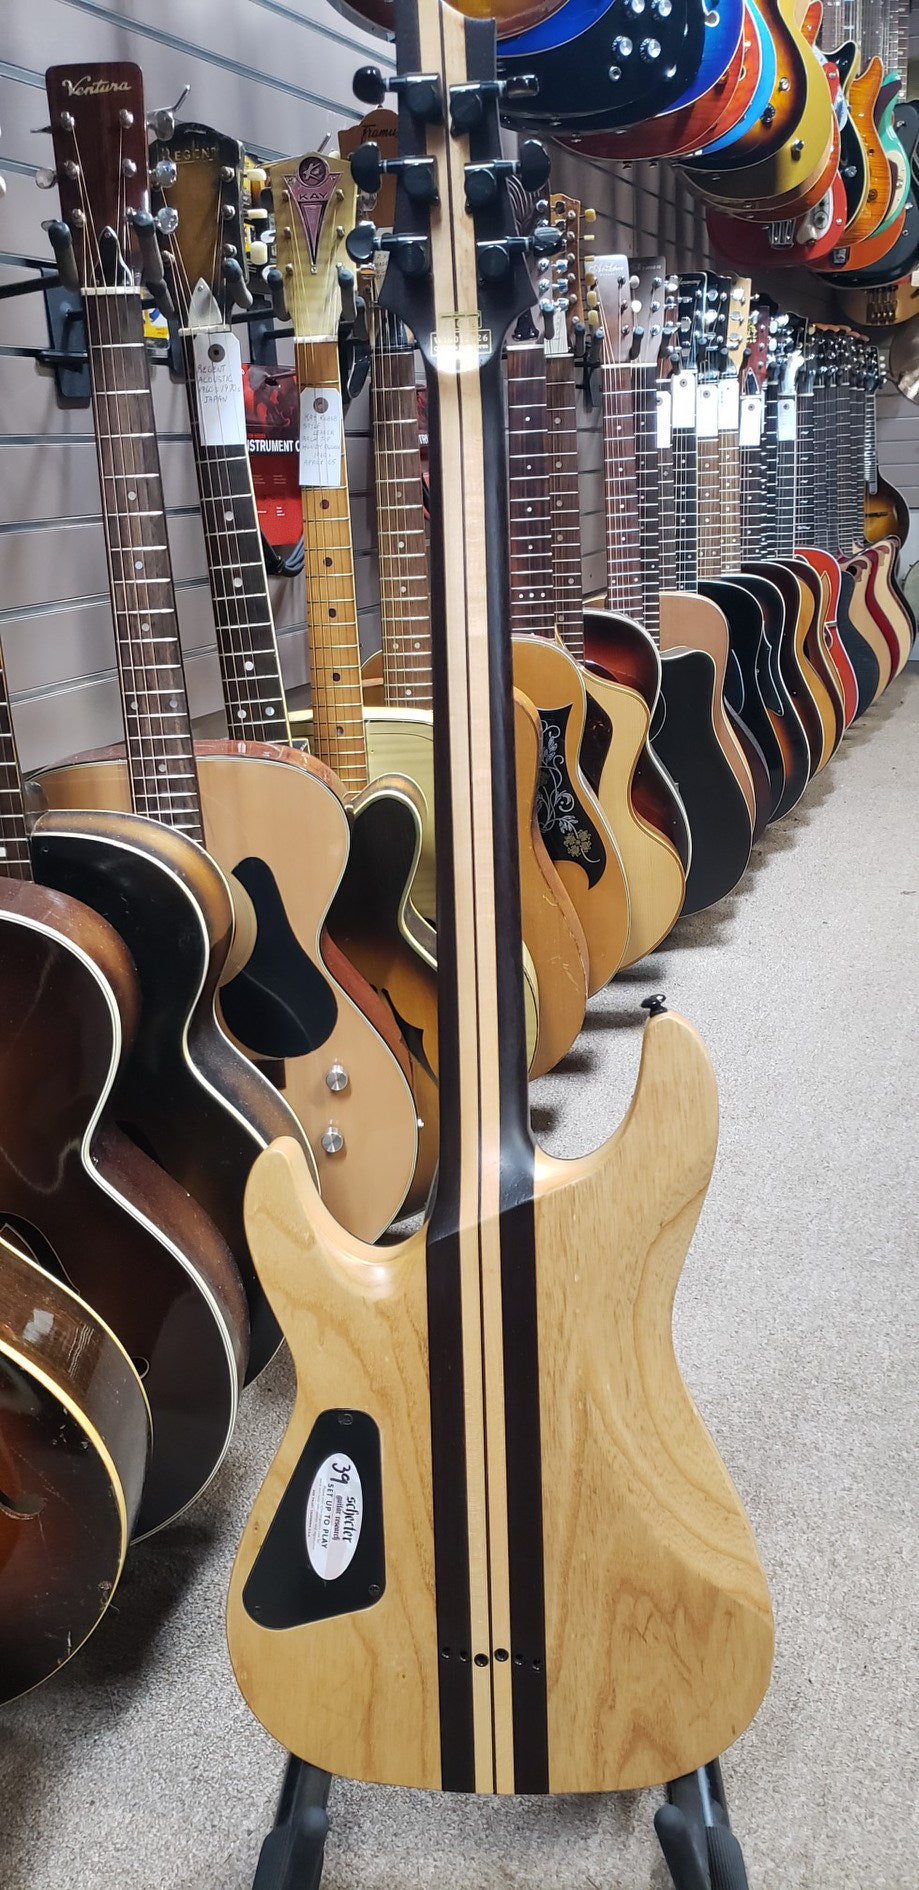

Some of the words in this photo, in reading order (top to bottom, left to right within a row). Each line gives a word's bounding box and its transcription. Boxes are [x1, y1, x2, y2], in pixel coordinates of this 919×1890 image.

[62, 75, 132, 97] Ventura
[361, 124, 398, 144] Framu
[299, 192, 328, 200] KAY
[330, 1463, 351, 1484] 39
[327, 1483, 335, 1497] SET
[325, 1500, 333, 1512] UP
[324, 1514, 331, 1526] TO
[332, 1516, 341, 1541] research
[342, 1496, 359, 1543] schecter
[321, 1529, 330, 1549] PLAY
